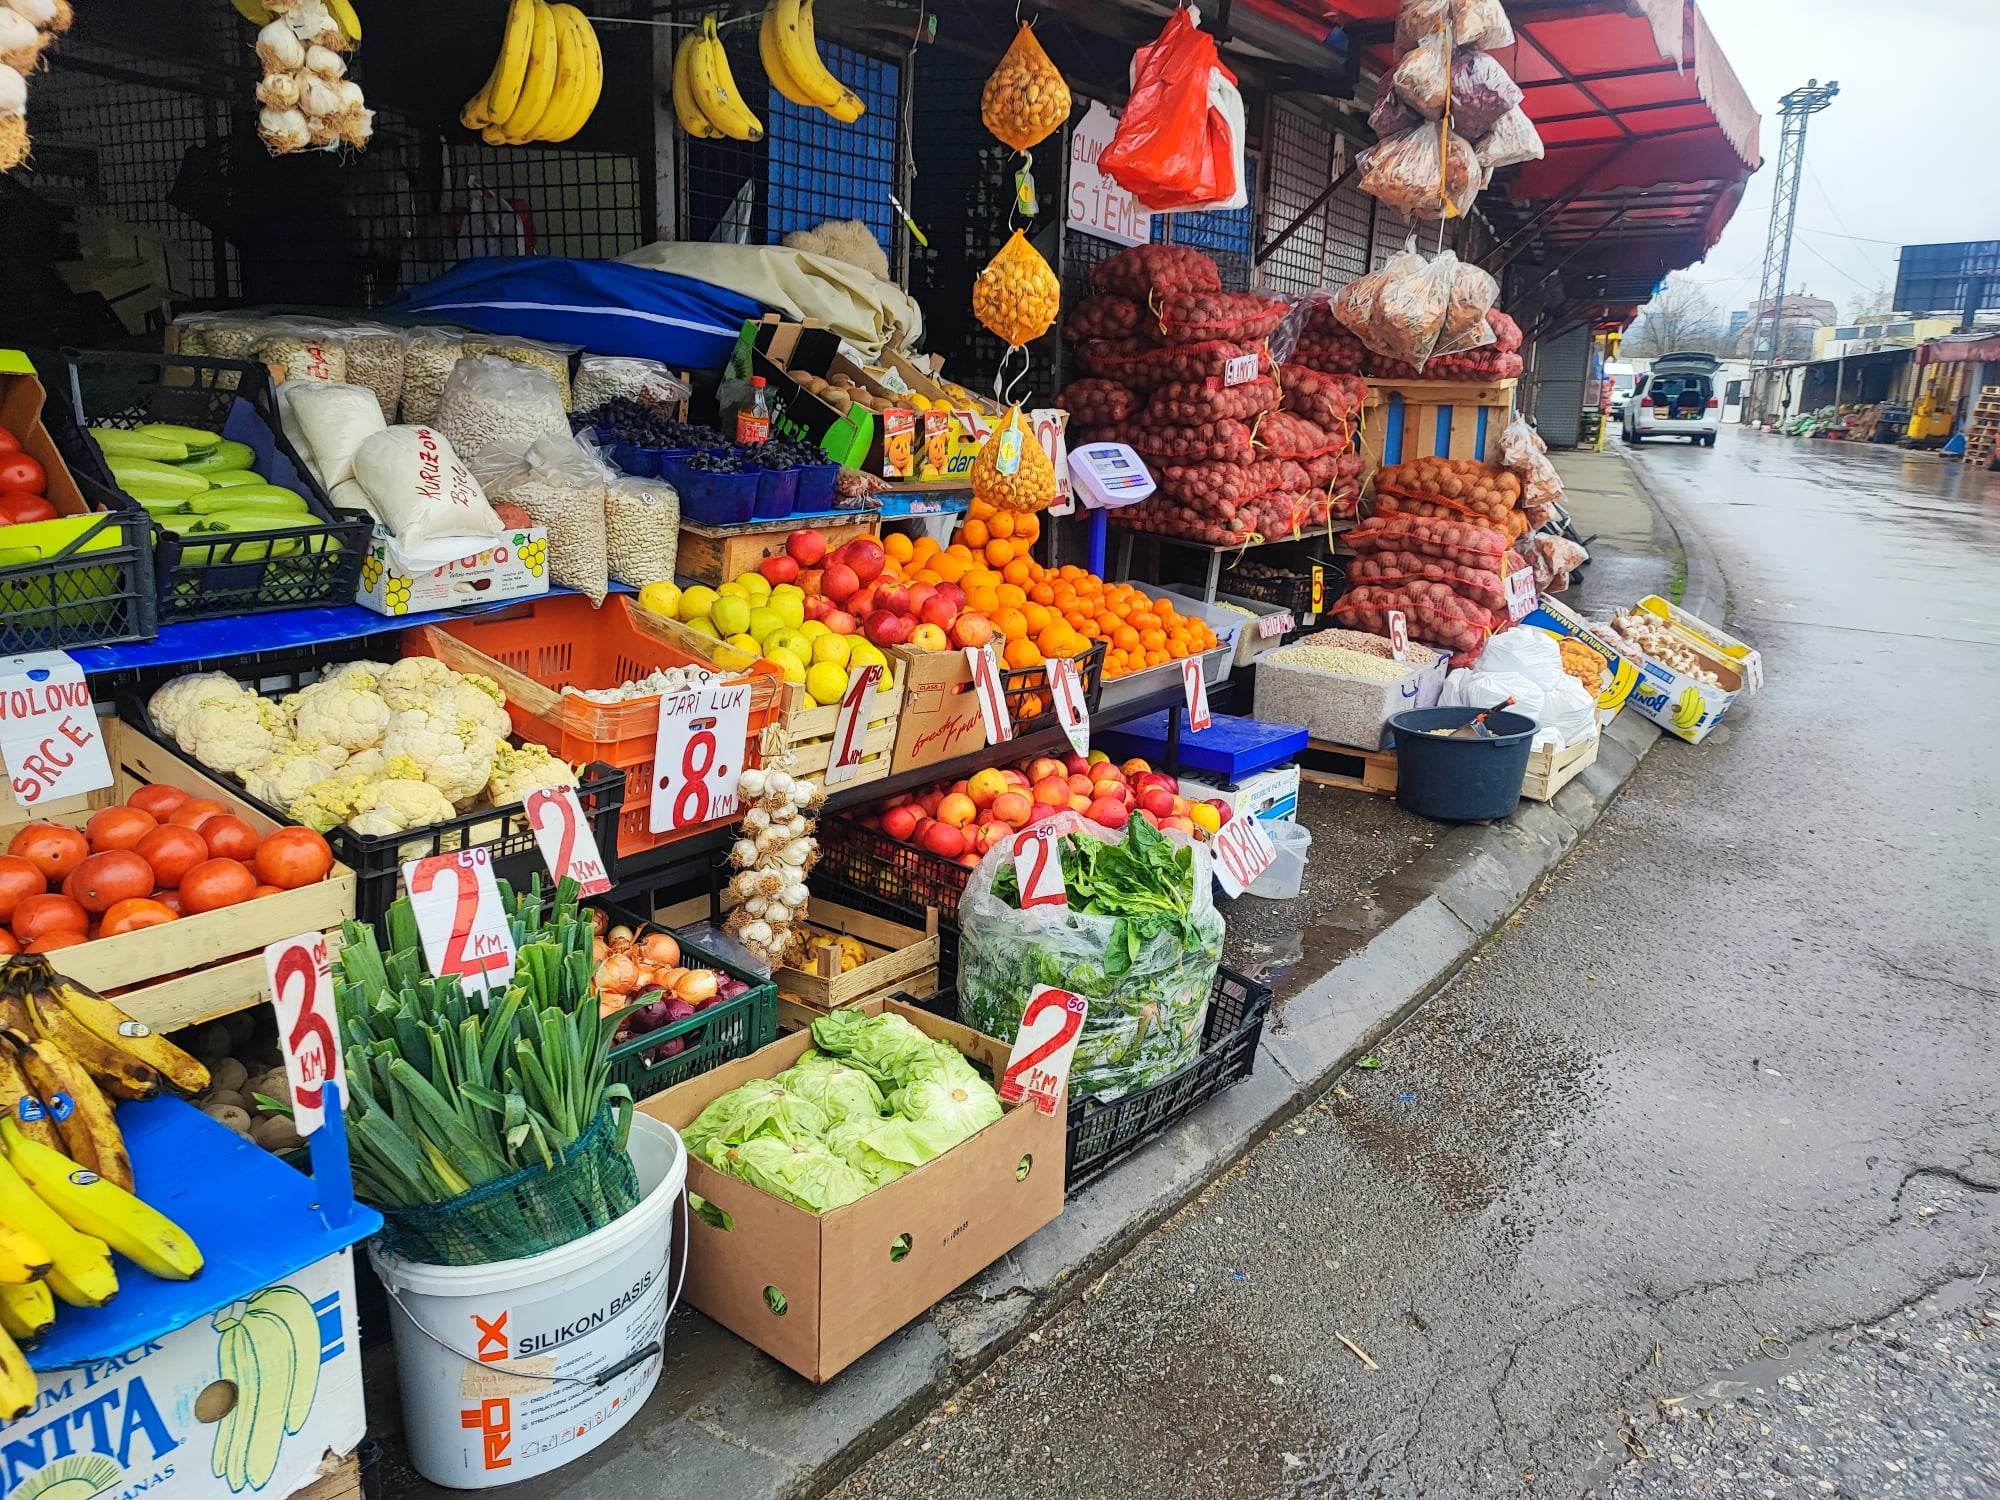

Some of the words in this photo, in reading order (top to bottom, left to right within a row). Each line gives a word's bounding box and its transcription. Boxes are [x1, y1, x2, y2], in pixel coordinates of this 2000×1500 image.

[1070, 181, 1147, 240] SJEME
[1313, 569, 1323, 604] 5
[1540, 603, 1580, 635] BANANAS
[1392, 613, 1403, 652] 6
[1580, 632, 1617, 661] PREMIUM
[667, 692, 701, 716] JARI
[710, 688, 744, 710] LUK
[836, 666, 872, 768] 1
[976, 651, 1004, 743] 1
[1053, 659, 1079, 726] 1
[1185, 659, 1209, 731] 2
[13, 715, 94, 802] SRCE
[673, 731, 716, 828] 8
[459, 848, 486, 868] 50
[1039, 826, 1054, 837] 50
[1013, 830, 1068, 910] 2
[411, 852, 509, 977] 2
[275, 945, 336, 1109] 3
[1067, 997, 1085, 1012] 50
[1000, 989, 1083, 1114] 2
[519, 1308, 604, 1354] SILIKON
[610, 1270, 652, 1316] BASIS
[0, 1376, 180, 1500] NITA
